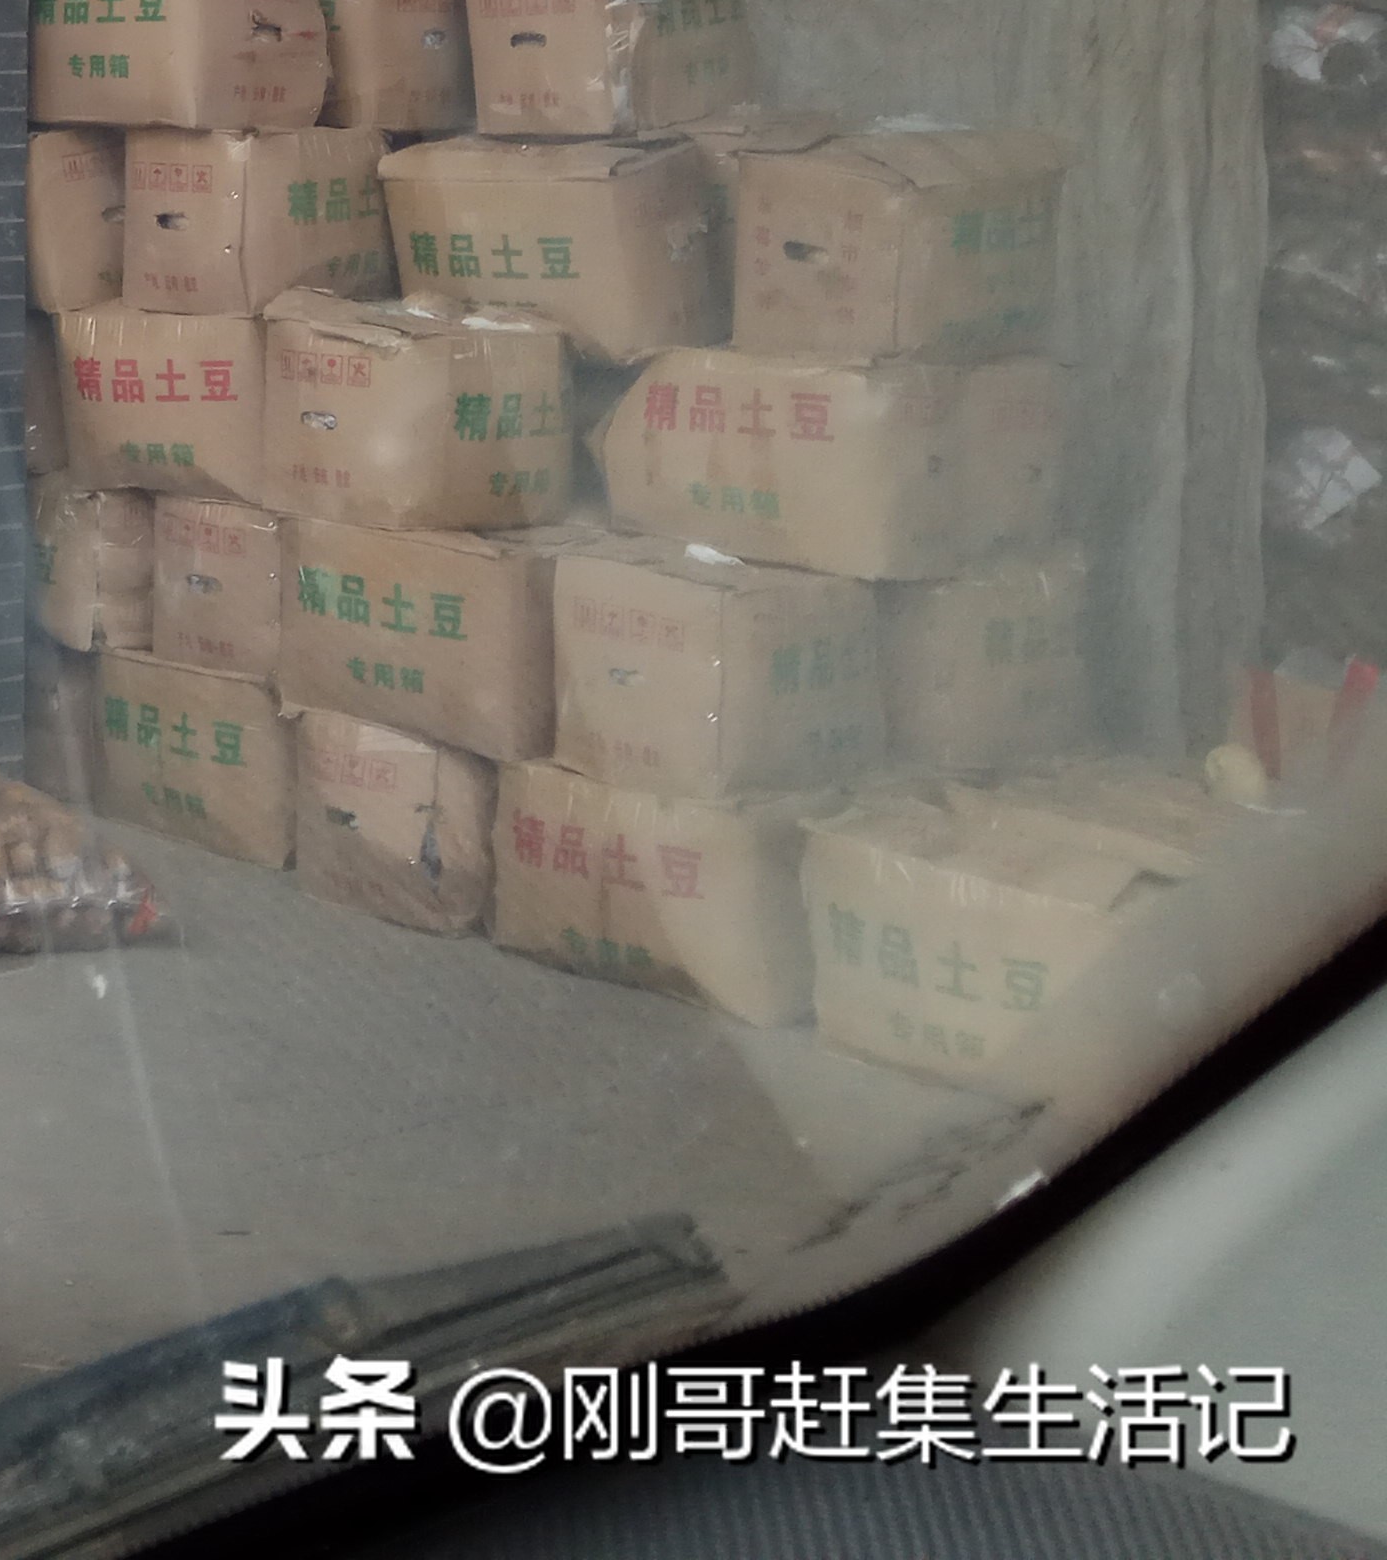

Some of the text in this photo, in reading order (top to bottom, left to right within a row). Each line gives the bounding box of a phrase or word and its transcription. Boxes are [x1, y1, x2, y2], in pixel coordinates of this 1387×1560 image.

[67, 53, 130, 80] 专用箱
[287, 178, 380, 226] 精品土
[409, 231, 581, 281] 精品土豆
[73, 357, 239, 403] 精品土豆
[453, 391, 558, 442] 精品土
[643, 382, 836, 443] 精品土豆
[297, 567, 468, 641] 精品土豆
[346, 656, 426, 695] 专用箱
[104, 696, 248, 769] 精品土豆
[512, 807, 705, 901] 精品土豆
[829, 901, 1051, 1013] 精品土豆
